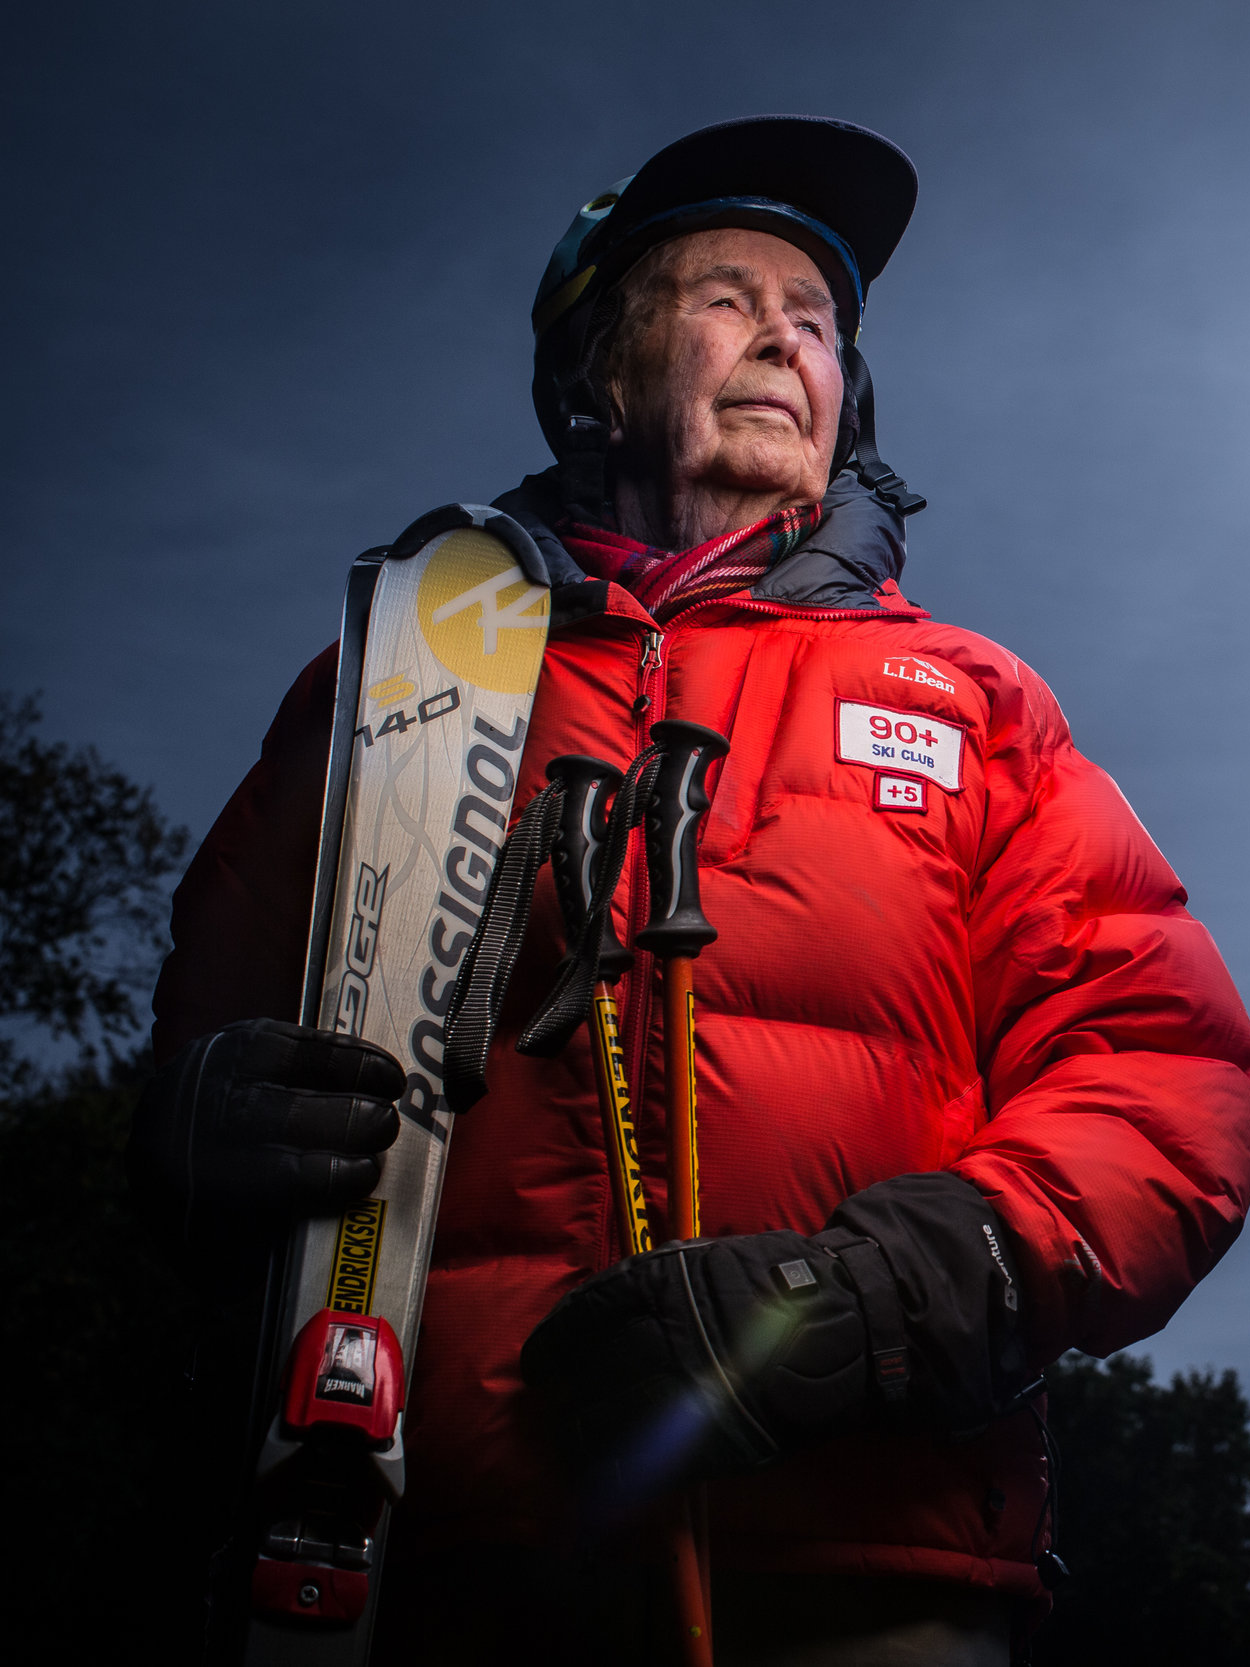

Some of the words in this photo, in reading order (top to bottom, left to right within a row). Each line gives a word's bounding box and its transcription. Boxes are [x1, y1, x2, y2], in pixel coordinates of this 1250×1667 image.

[882, 662, 956, 695] L.L.Bean
[353, 686, 461, 748] 140
[869, 715, 939, 748] 90+
[871, 743, 895, 759] SKI
[901, 749, 935, 769] CLUB
[886, 784, 919, 803] +5
[323, 1378, 366, 1399] MARKER
